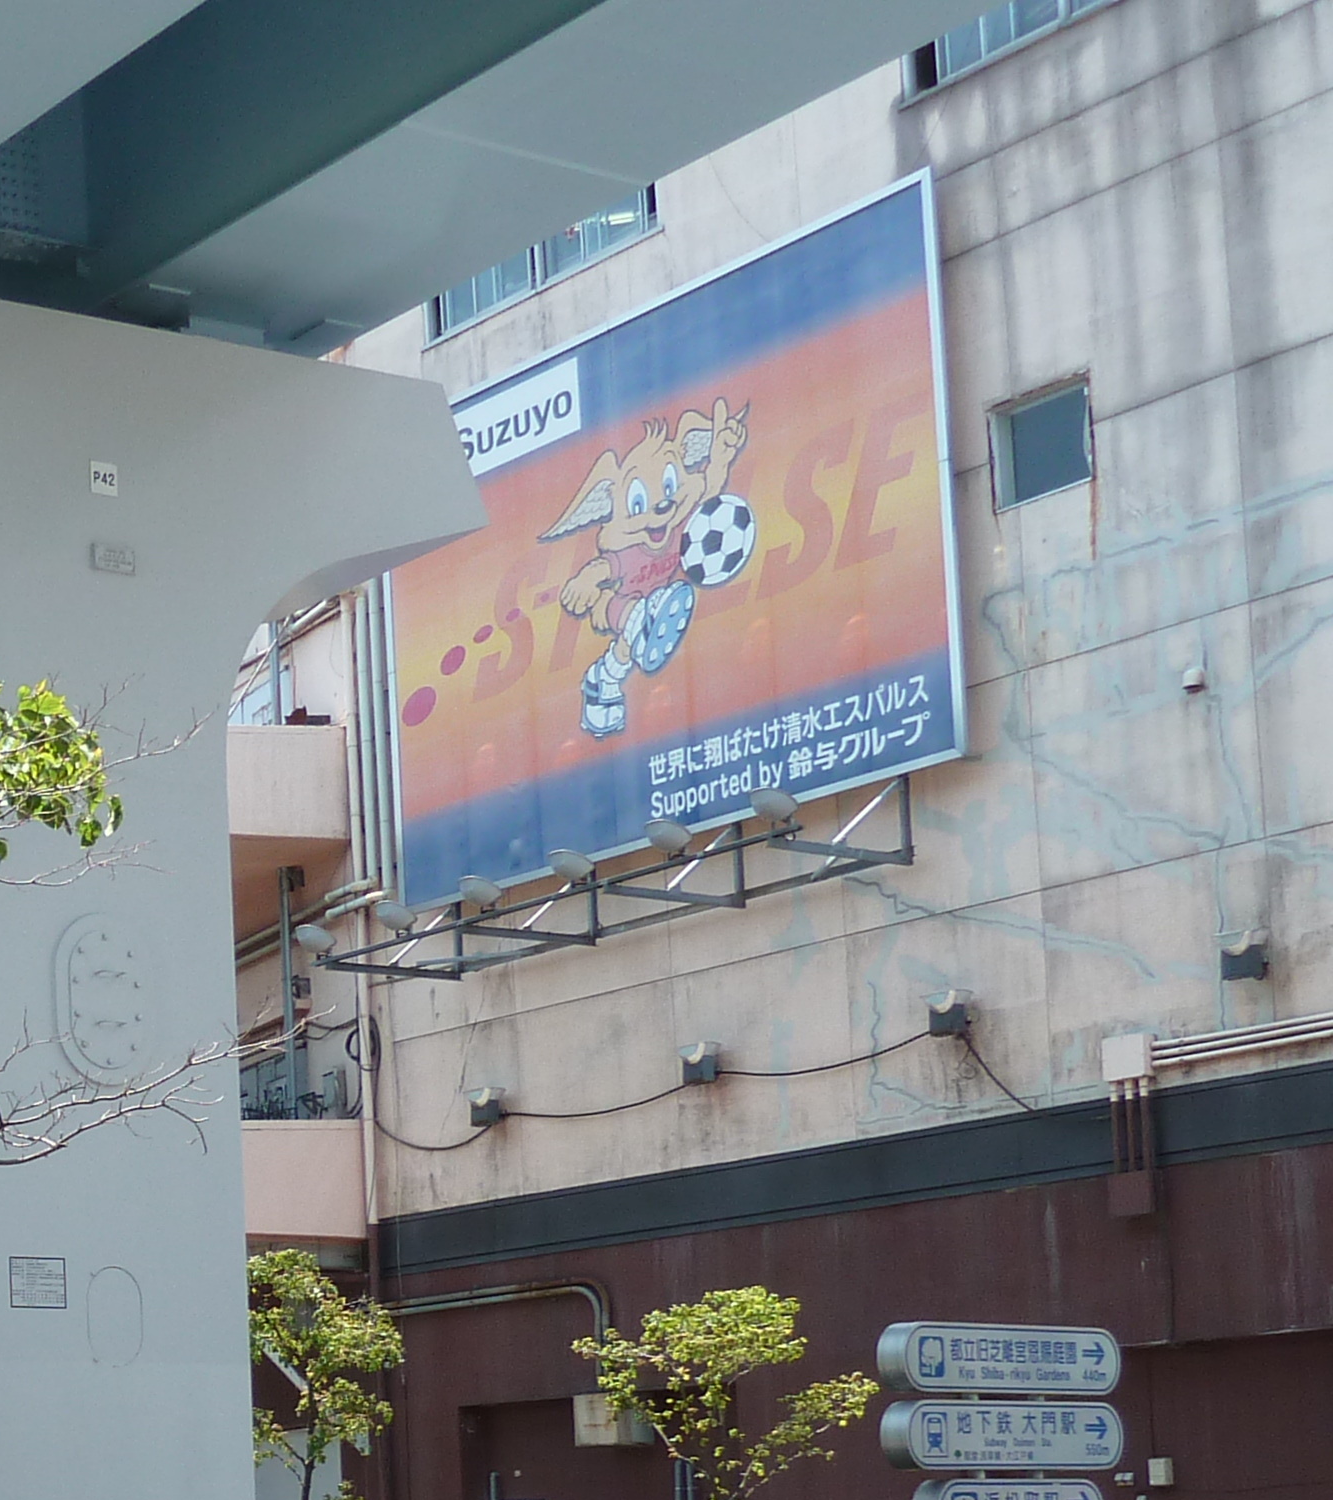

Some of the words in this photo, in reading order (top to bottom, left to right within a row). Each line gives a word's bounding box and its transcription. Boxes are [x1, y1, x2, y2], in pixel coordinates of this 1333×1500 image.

[459, 390, 572, 460] Suzuyo
[92, 470, 116, 487] P42
[648, 674, 930, 786] 世界に翔ばたけ清水エスパルス
[650, 762, 752, 818] Supported
[758, 759, 784, 789] by
[787, 711, 931, 781] 鈴与グループ
[958, 1367, 975, 1381] Kyu
[1035, 1368, 1071, 1381] Gardens
[956, 1411, 1013, 1434] 地下鉄
[1021, 1411, 1077, 1435] 大門駅
